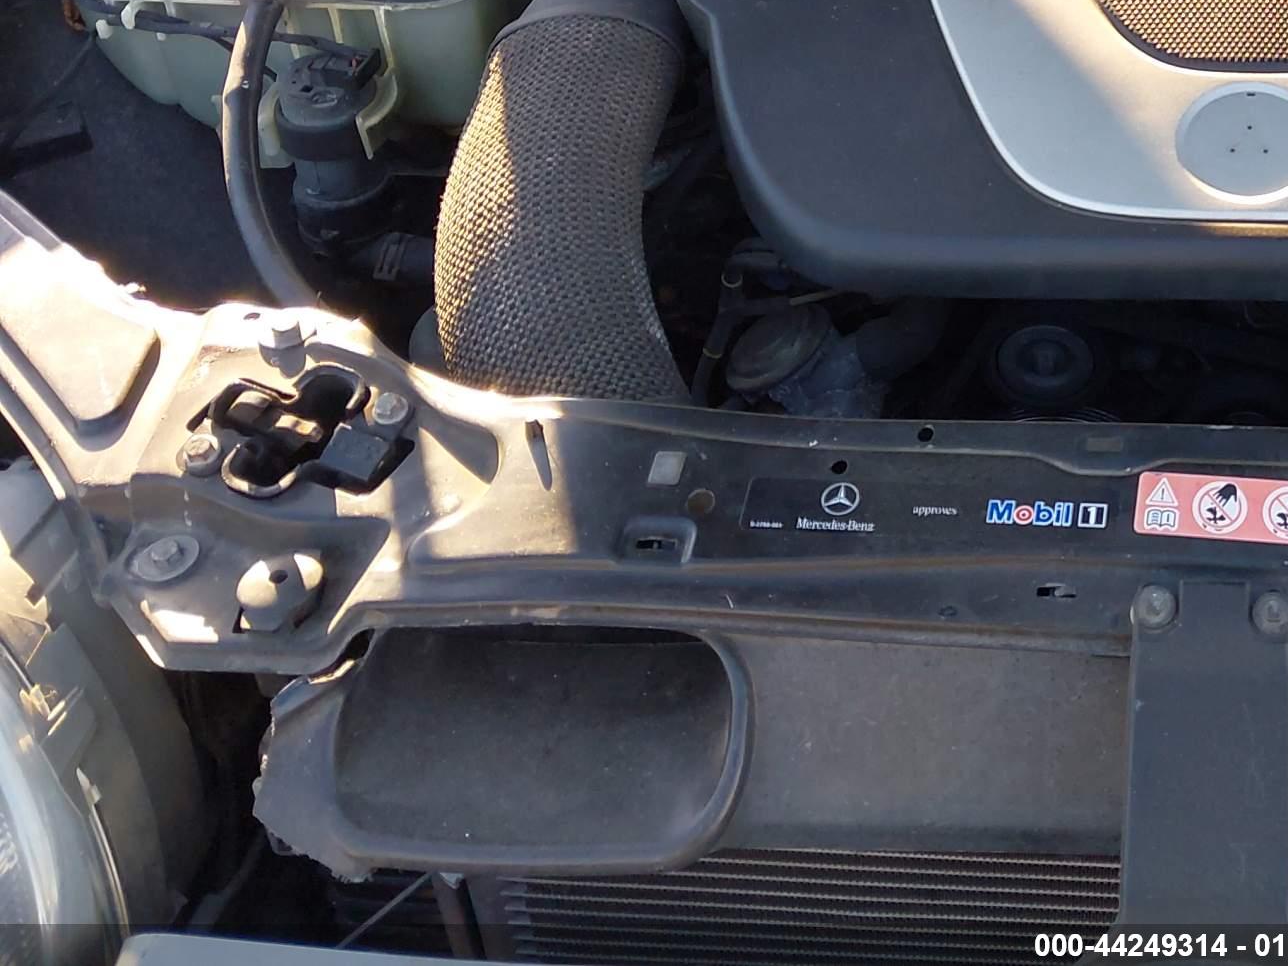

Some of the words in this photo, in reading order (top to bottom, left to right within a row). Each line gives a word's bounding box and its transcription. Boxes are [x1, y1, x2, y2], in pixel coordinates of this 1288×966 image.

[912, 505, 958, 516] approves
[986, 500, 1074, 527] Mobil
[796, 517, 875, 532] Mercedes-Benz
